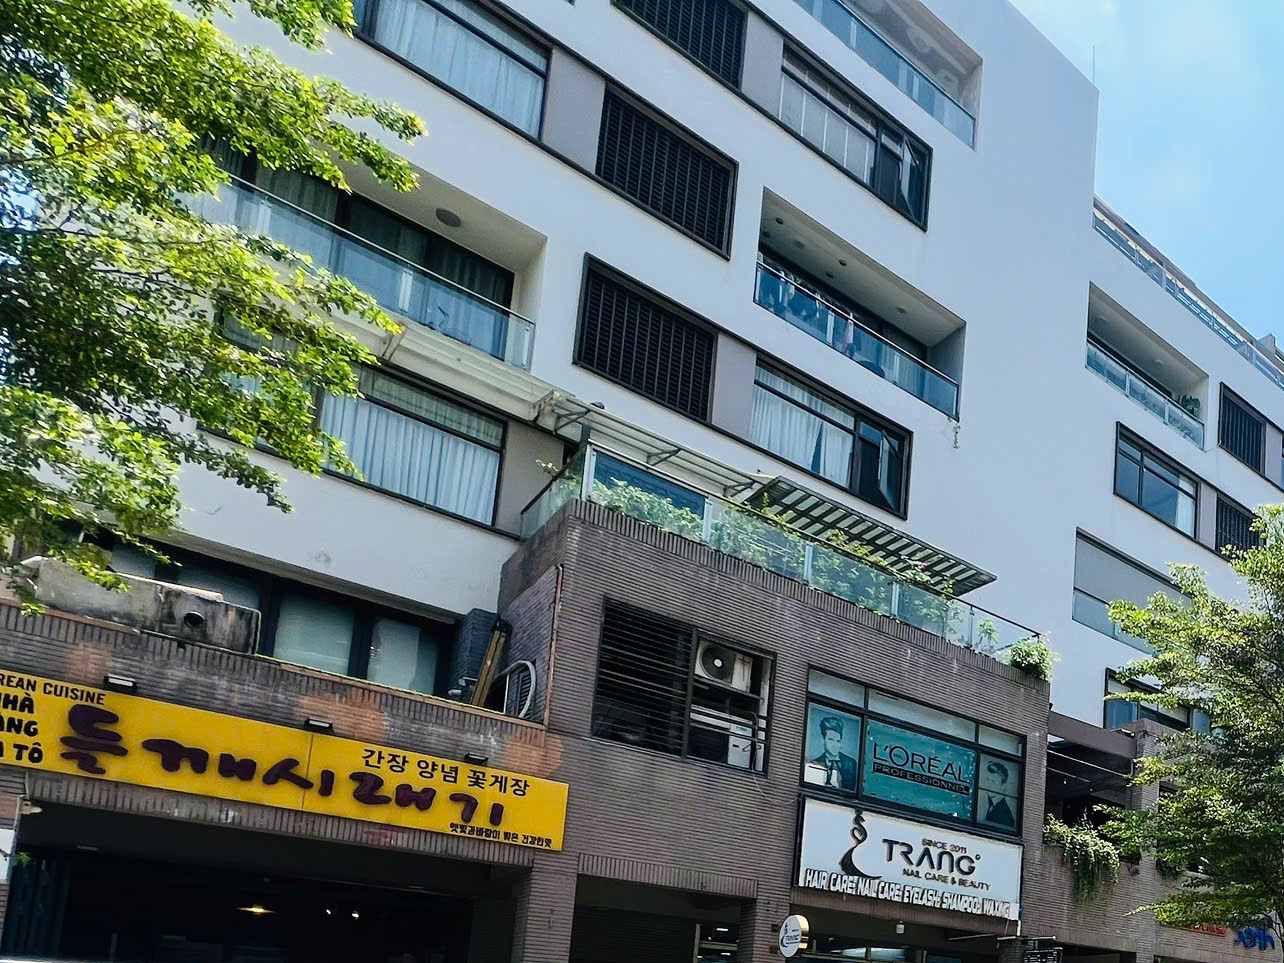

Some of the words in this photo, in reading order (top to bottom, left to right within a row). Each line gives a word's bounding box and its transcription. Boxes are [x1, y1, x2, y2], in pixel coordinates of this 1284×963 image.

[0, 692, 34, 714] HÀ
[43, 682, 106, 706] CUISINE
[13, 741, 43, 763] TÔ
[361, 748, 410, 773] 간장
[416, 758, 460, 784] 양념
[467, 768, 530, 797] 꽃게장
[873, 762, 970, 796] PROFESSIONNEL
[921, 838, 948, 850] SINCE
[806, 869, 828, 890] HAIR
[858, 877, 878, 898] NAIL
[902, 868, 922, 879] NAIL
[924, 871, 949, 884] CARE
[958, 878, 991, 890] BEAUTY
